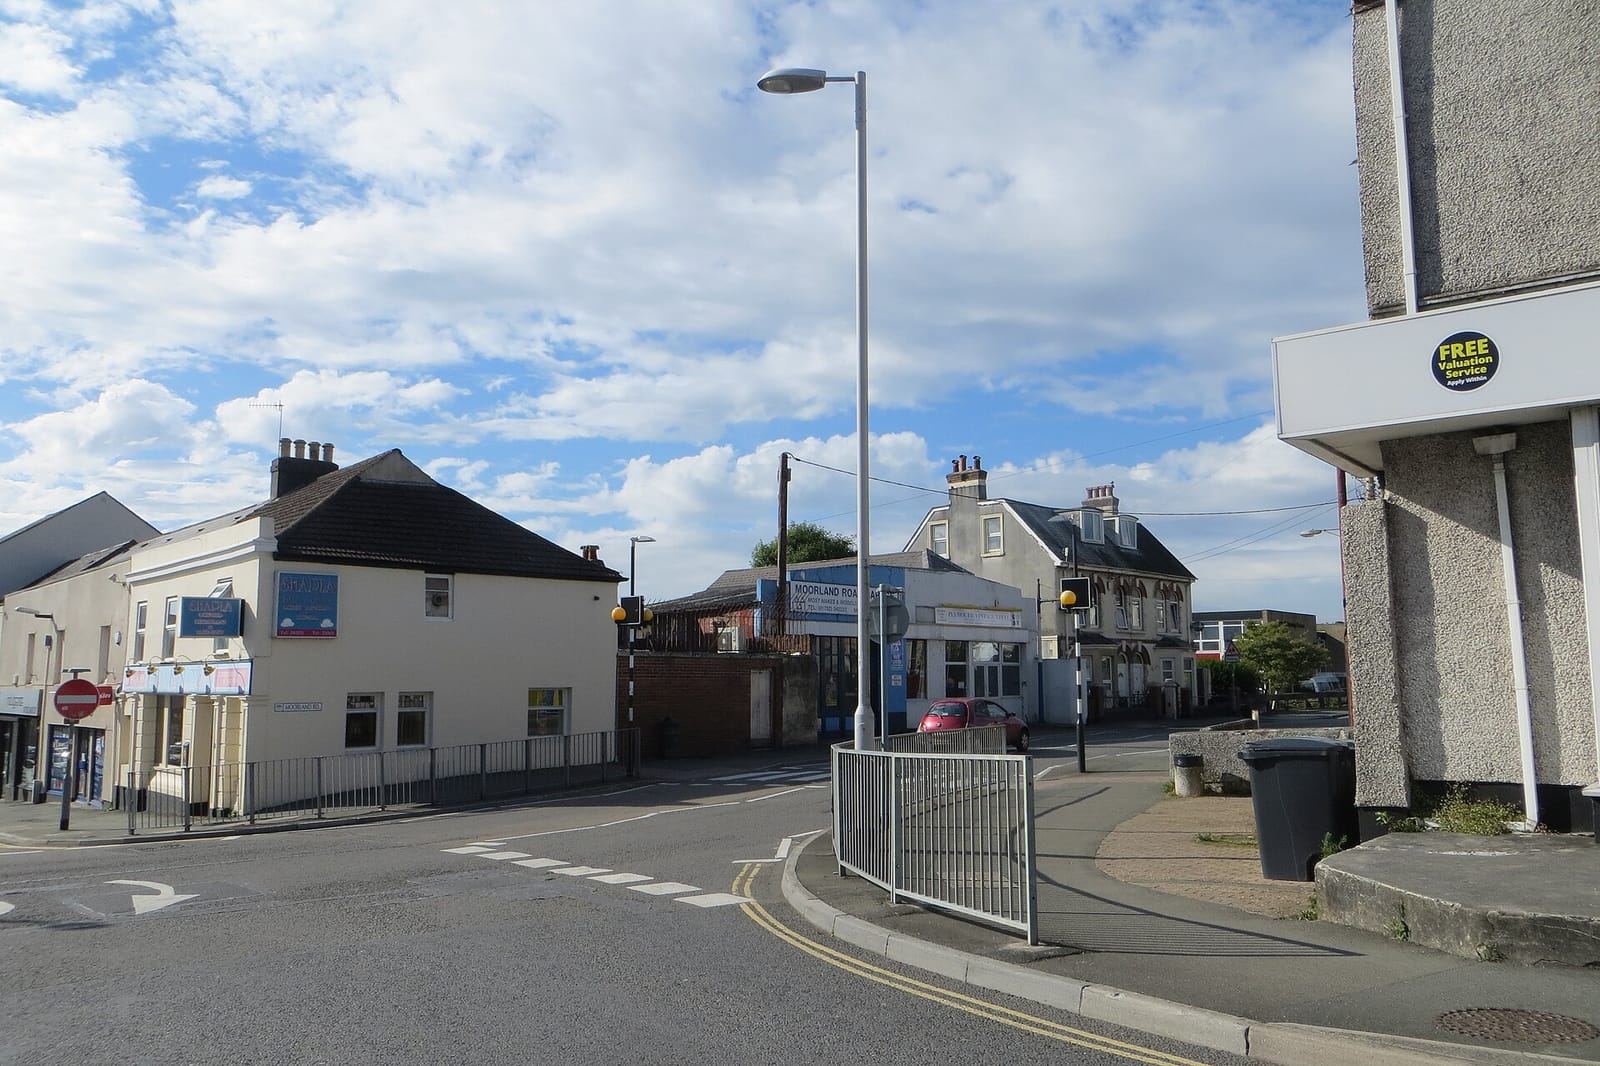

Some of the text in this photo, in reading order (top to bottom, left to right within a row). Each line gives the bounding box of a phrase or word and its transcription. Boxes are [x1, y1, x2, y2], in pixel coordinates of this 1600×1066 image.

[1439, 338, 1489, 361] FREE
[1438, 356, 1493, 370] Valuation
[1445, 366, 1488, 379] Service
[1447, 378, 1465, 386] Apply
[795, 584, 840, 597] MOORLAND
[841, 588, 858, 599] ROA
